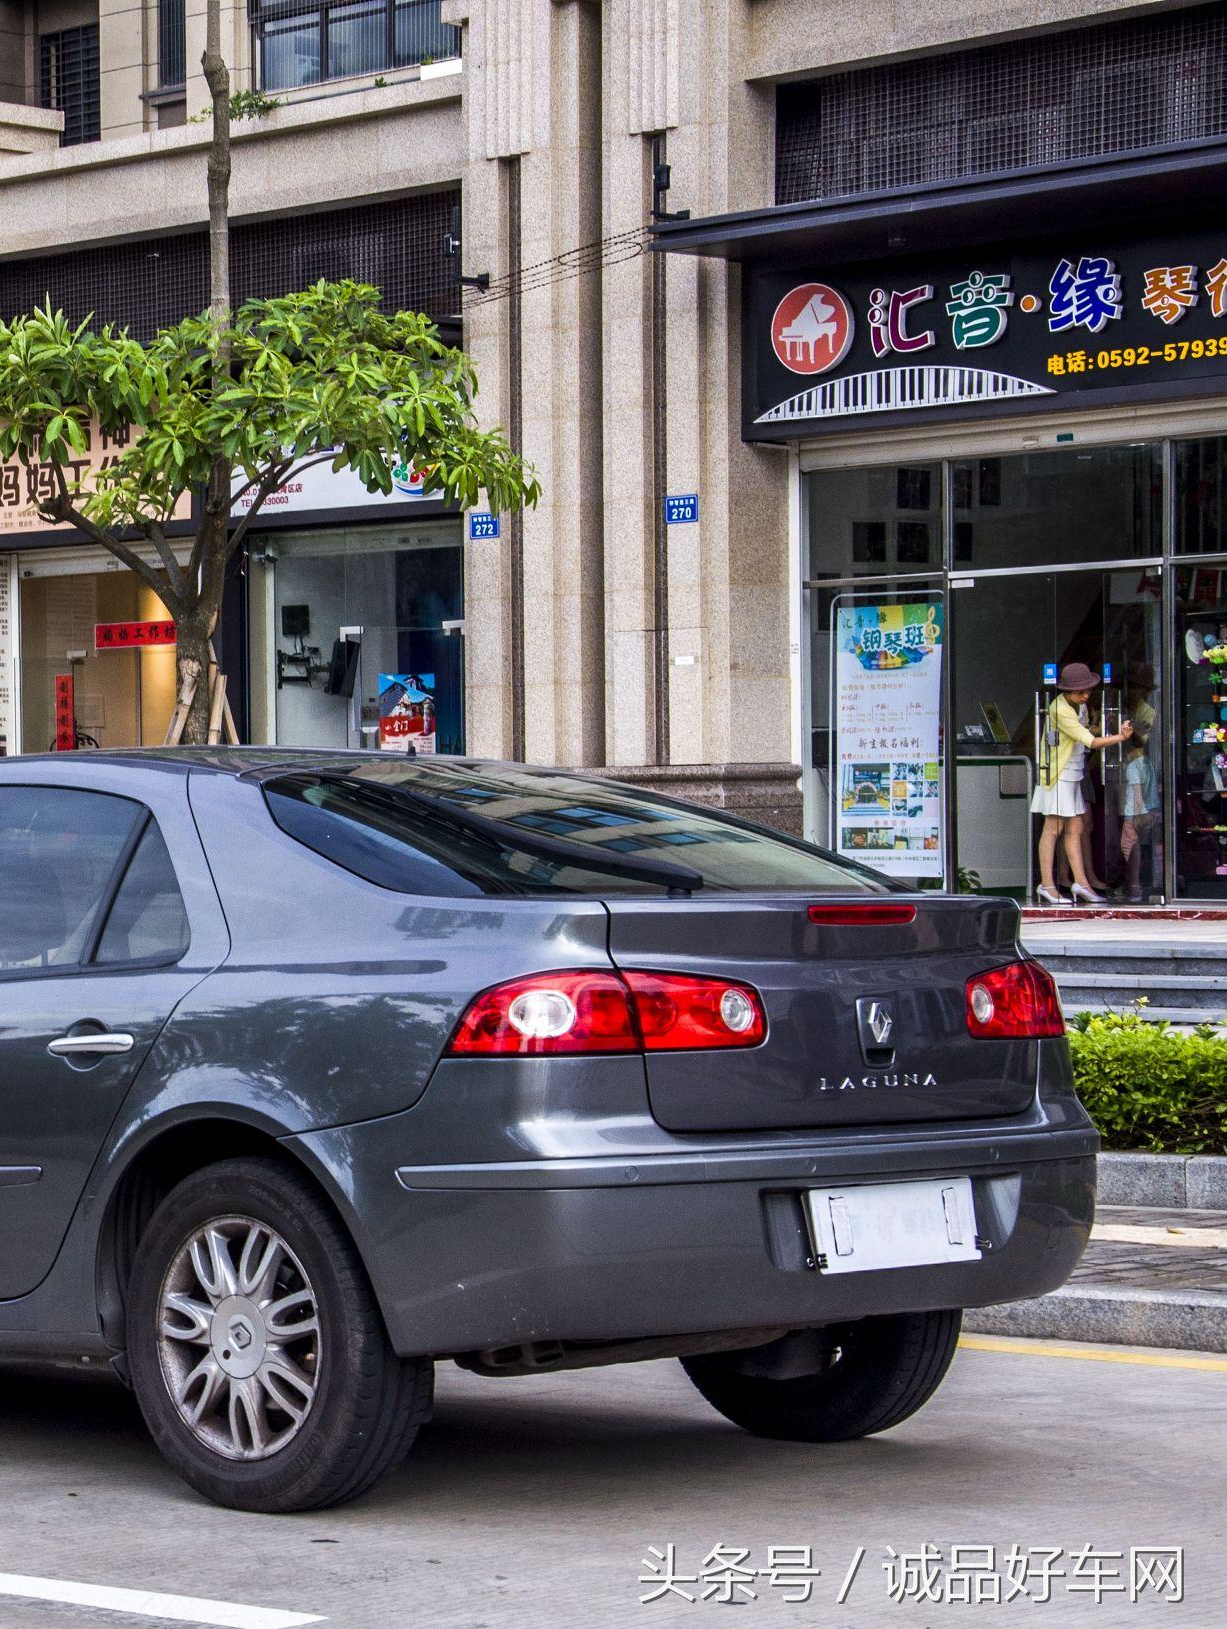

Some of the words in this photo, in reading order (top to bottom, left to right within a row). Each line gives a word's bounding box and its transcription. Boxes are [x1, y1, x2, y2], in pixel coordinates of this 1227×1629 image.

[672, 507, 692, 520] 270
[475, 523, 494, 536] 272
[862, 625, 925, 654] 钢琴班
[820, 1073, 938, 1091] LAGUNA
